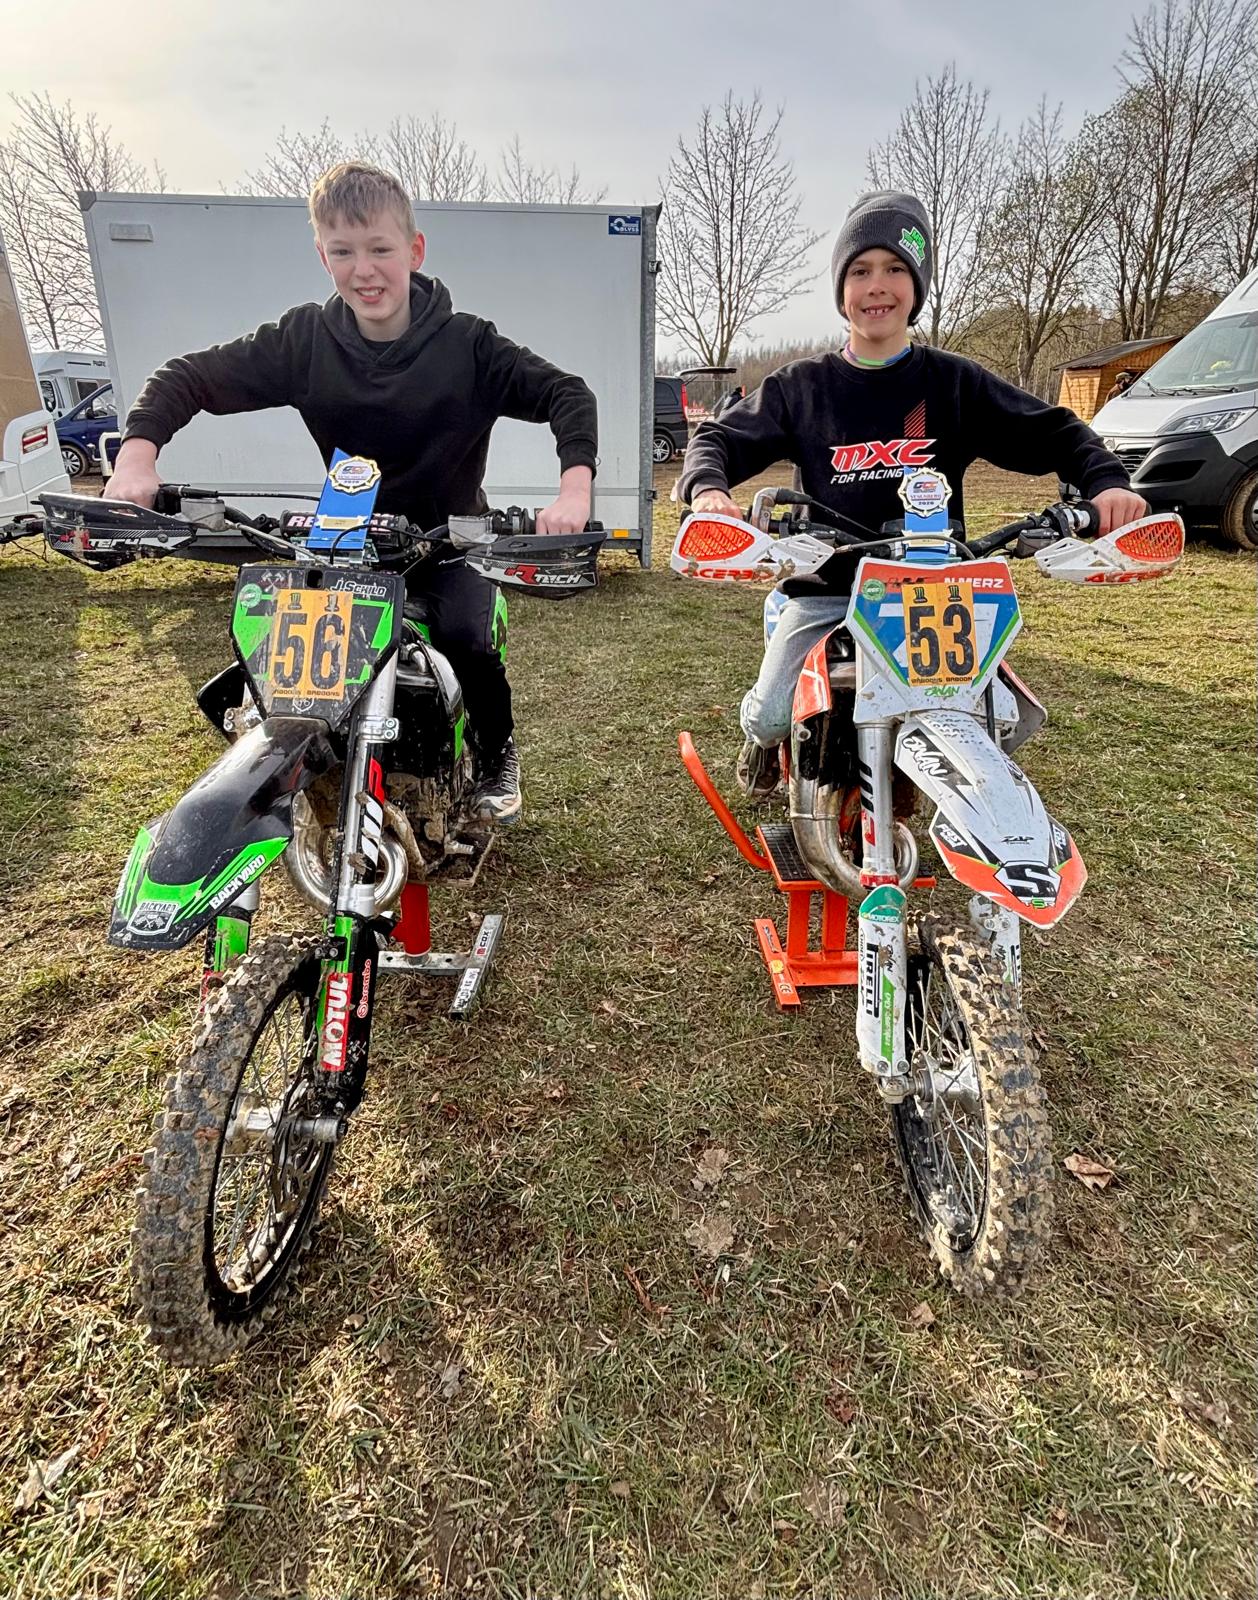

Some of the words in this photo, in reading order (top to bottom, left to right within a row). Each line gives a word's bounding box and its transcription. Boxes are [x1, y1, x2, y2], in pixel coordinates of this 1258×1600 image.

[829, 439, 937, 473] MXC
[830, 473, 856, 485] FOR
[859, 467, 904, 481] RACING
[273, 612, 346, 690] 56
[908, 603, 975, 678] 53
[208, 854, 266, 910] BACKYARD
[360, 958, 371, 1005] brembo
[866, 942, 880, 1018] PIRELLI
[323, 977, 349, 1067] MOTUL
